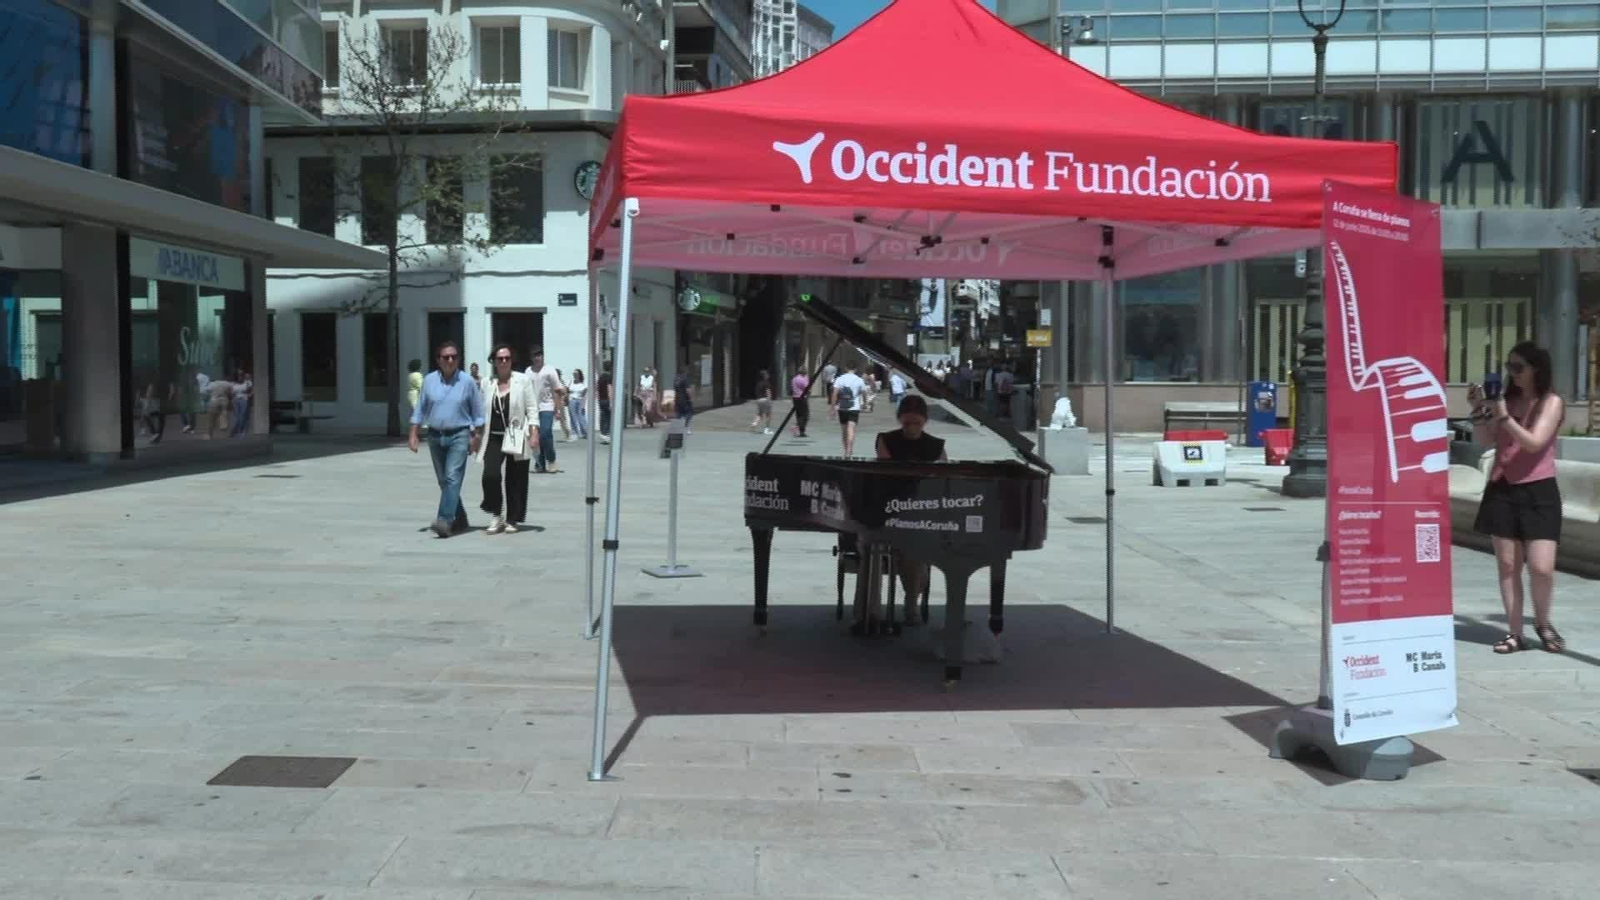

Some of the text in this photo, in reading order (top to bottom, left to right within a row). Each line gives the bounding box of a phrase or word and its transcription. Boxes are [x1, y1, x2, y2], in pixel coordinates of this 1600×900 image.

[831, 140, 1273, 202] Occident Fundación
[157, 248, 219, 284] ABANCA
[800, 479, 820, 497] MC
[885, 494, 984, 514] ¿Quieres tocar?
[1349, 655, 1380, 668] Occident
